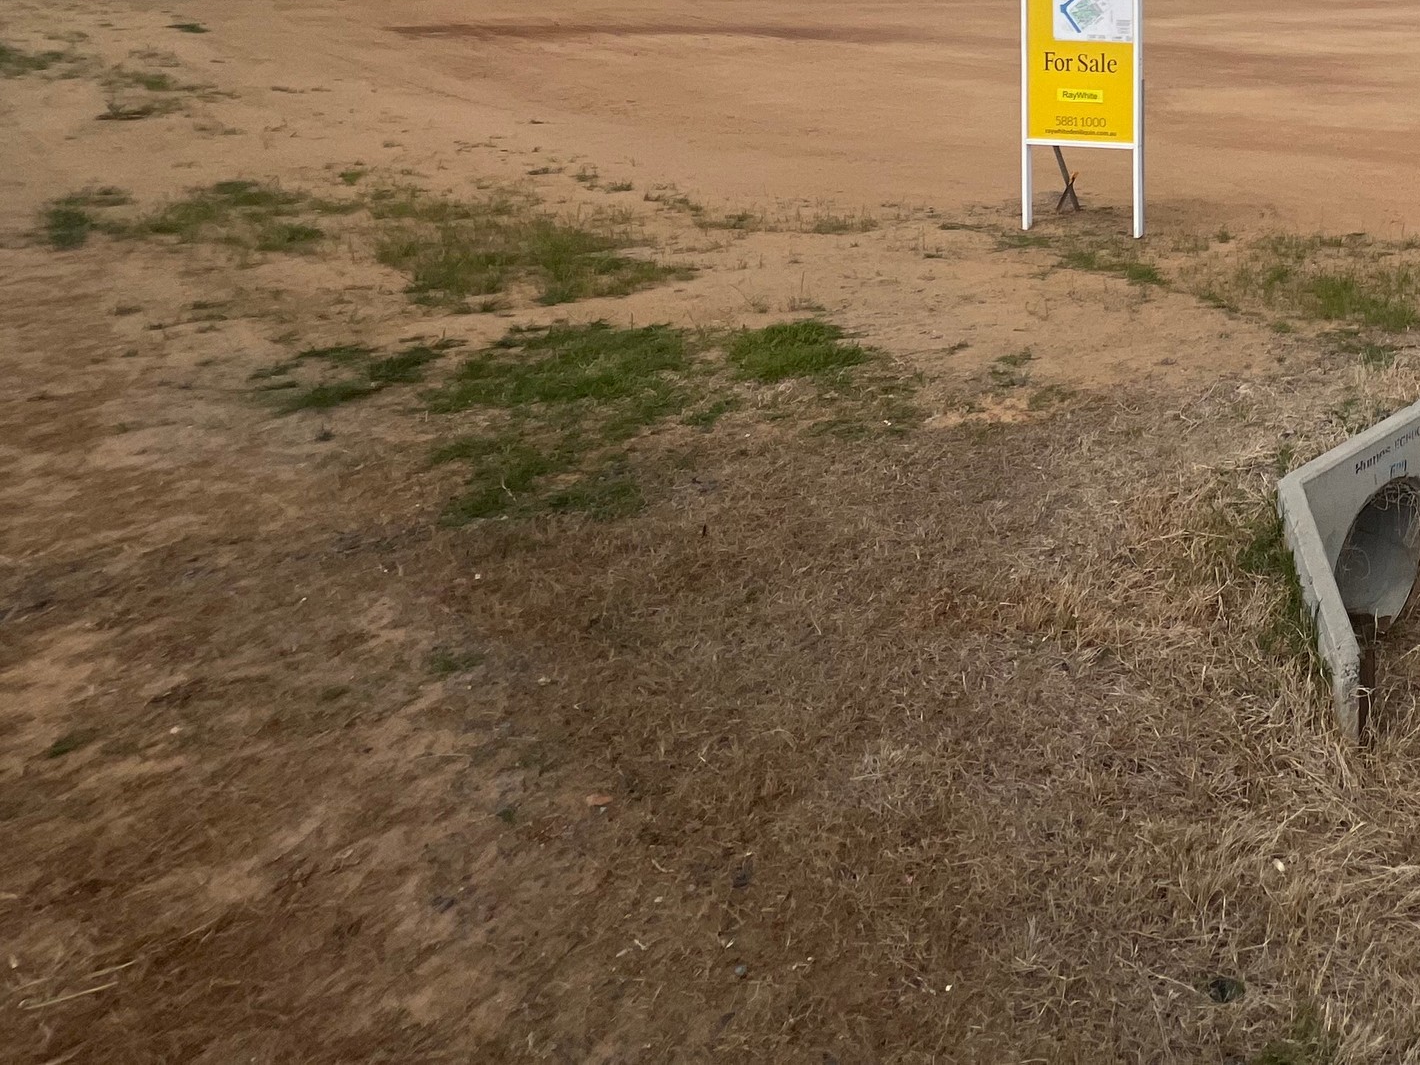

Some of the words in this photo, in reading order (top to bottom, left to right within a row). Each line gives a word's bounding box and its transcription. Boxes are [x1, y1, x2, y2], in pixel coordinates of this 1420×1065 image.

[1044, 52, 1073, 72] For
[1078, 53, 1117, 73] Sale
[1062, 90, 1098, 100] RayWhite
[1055, 115, 1078, 127] 5881
[1080, 116, 1107, 128] 1000
